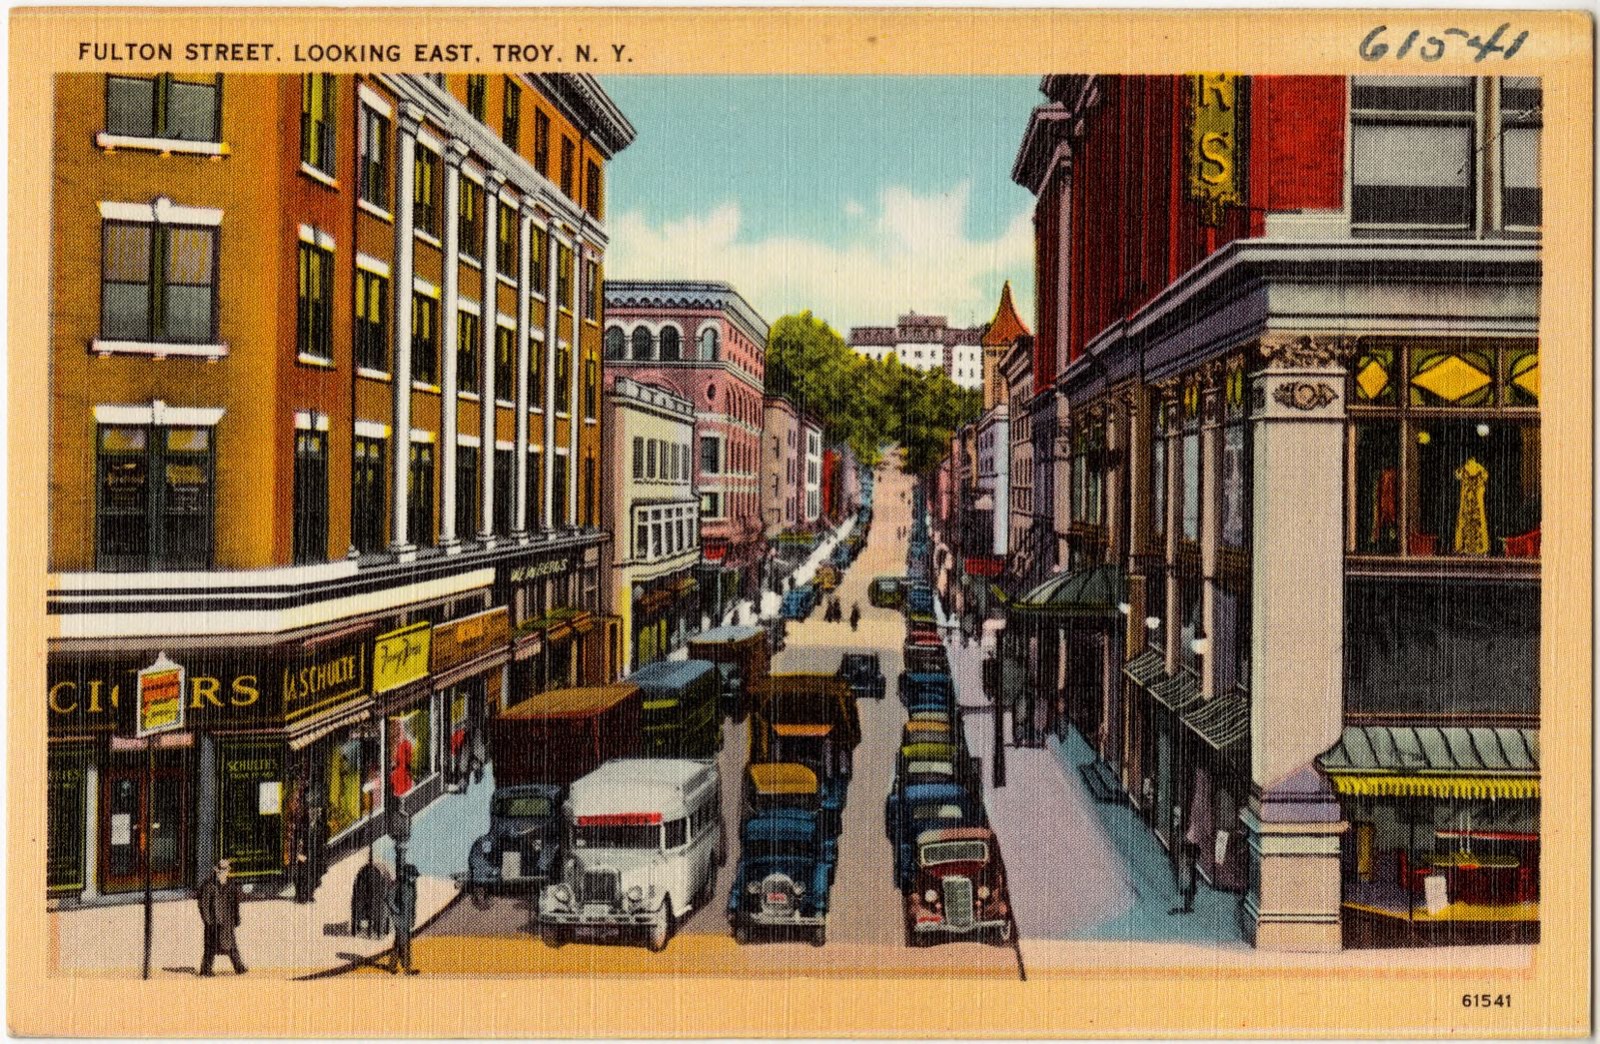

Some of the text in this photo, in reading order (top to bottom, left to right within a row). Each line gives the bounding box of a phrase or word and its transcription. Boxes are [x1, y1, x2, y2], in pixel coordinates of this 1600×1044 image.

[1359, 22, 1529, 63] 61541
[50, 674, 260, 714] CIRS
[300, 655, 357, 698] SCHULTE
